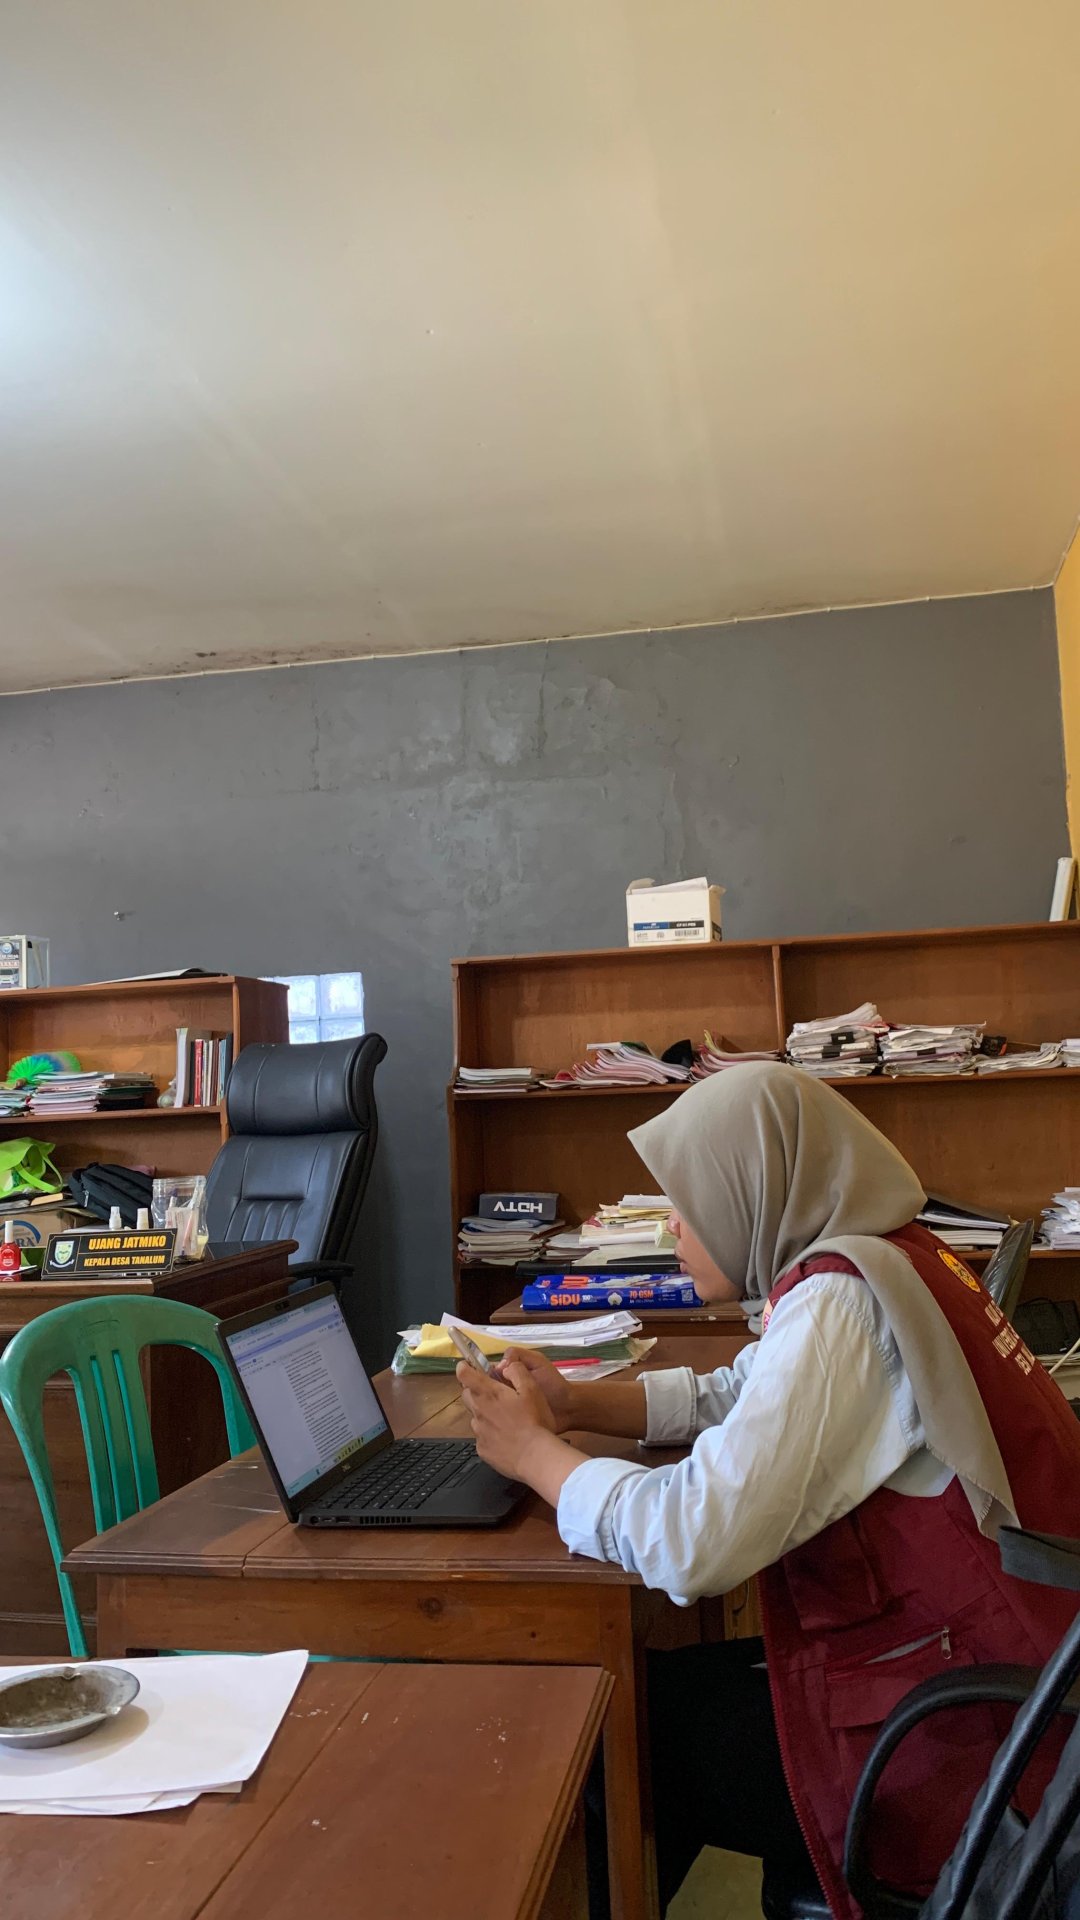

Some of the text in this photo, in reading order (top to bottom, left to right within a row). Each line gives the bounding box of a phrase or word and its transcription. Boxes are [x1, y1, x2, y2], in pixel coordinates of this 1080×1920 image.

[493, 1201, 543, 1213] HDTV
[88, 1235, 167, 1250] UJANG JATMIKO
[84, 1255, 165, 1267] KEPALA DESA TANALUM
[639, 1289, 654, 1298] GSM
